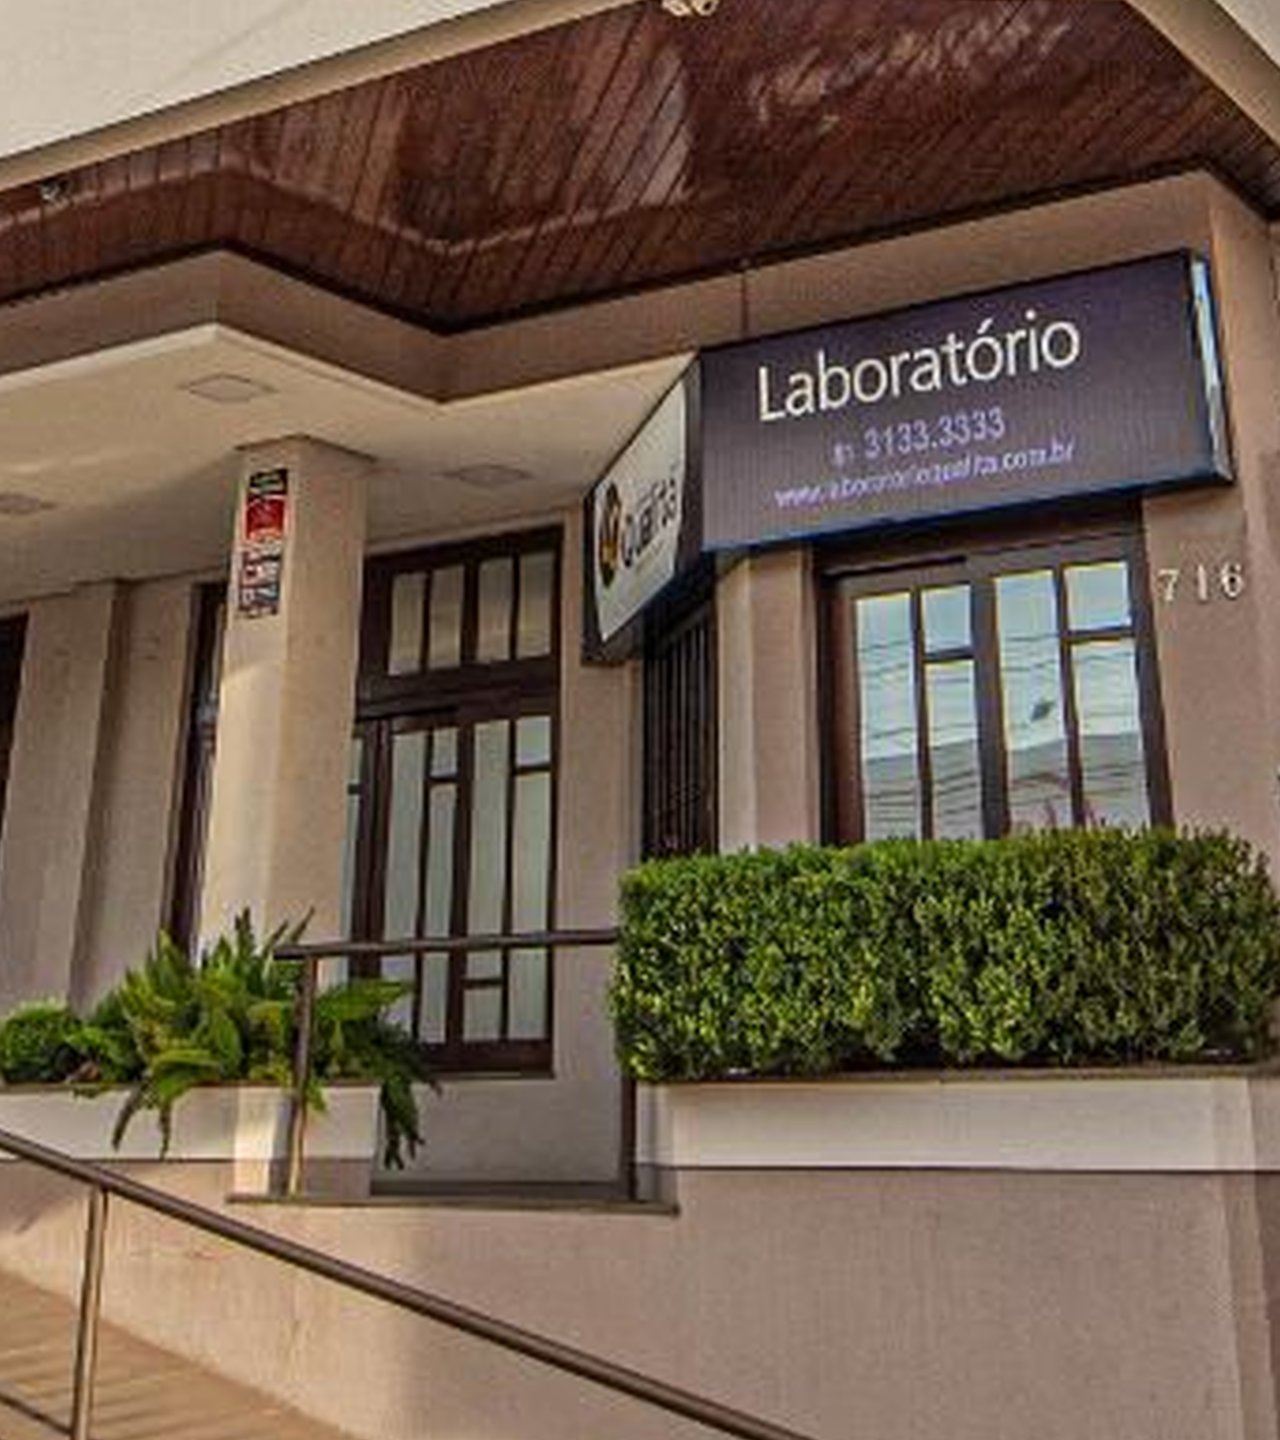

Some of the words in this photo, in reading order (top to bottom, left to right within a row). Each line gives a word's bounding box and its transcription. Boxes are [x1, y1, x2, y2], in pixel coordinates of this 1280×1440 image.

[758, 308, 1080, 422] Laboratório
[864, 405, 1006, 459] 3133.3333
[1158, 561, 1245, 602] 716
